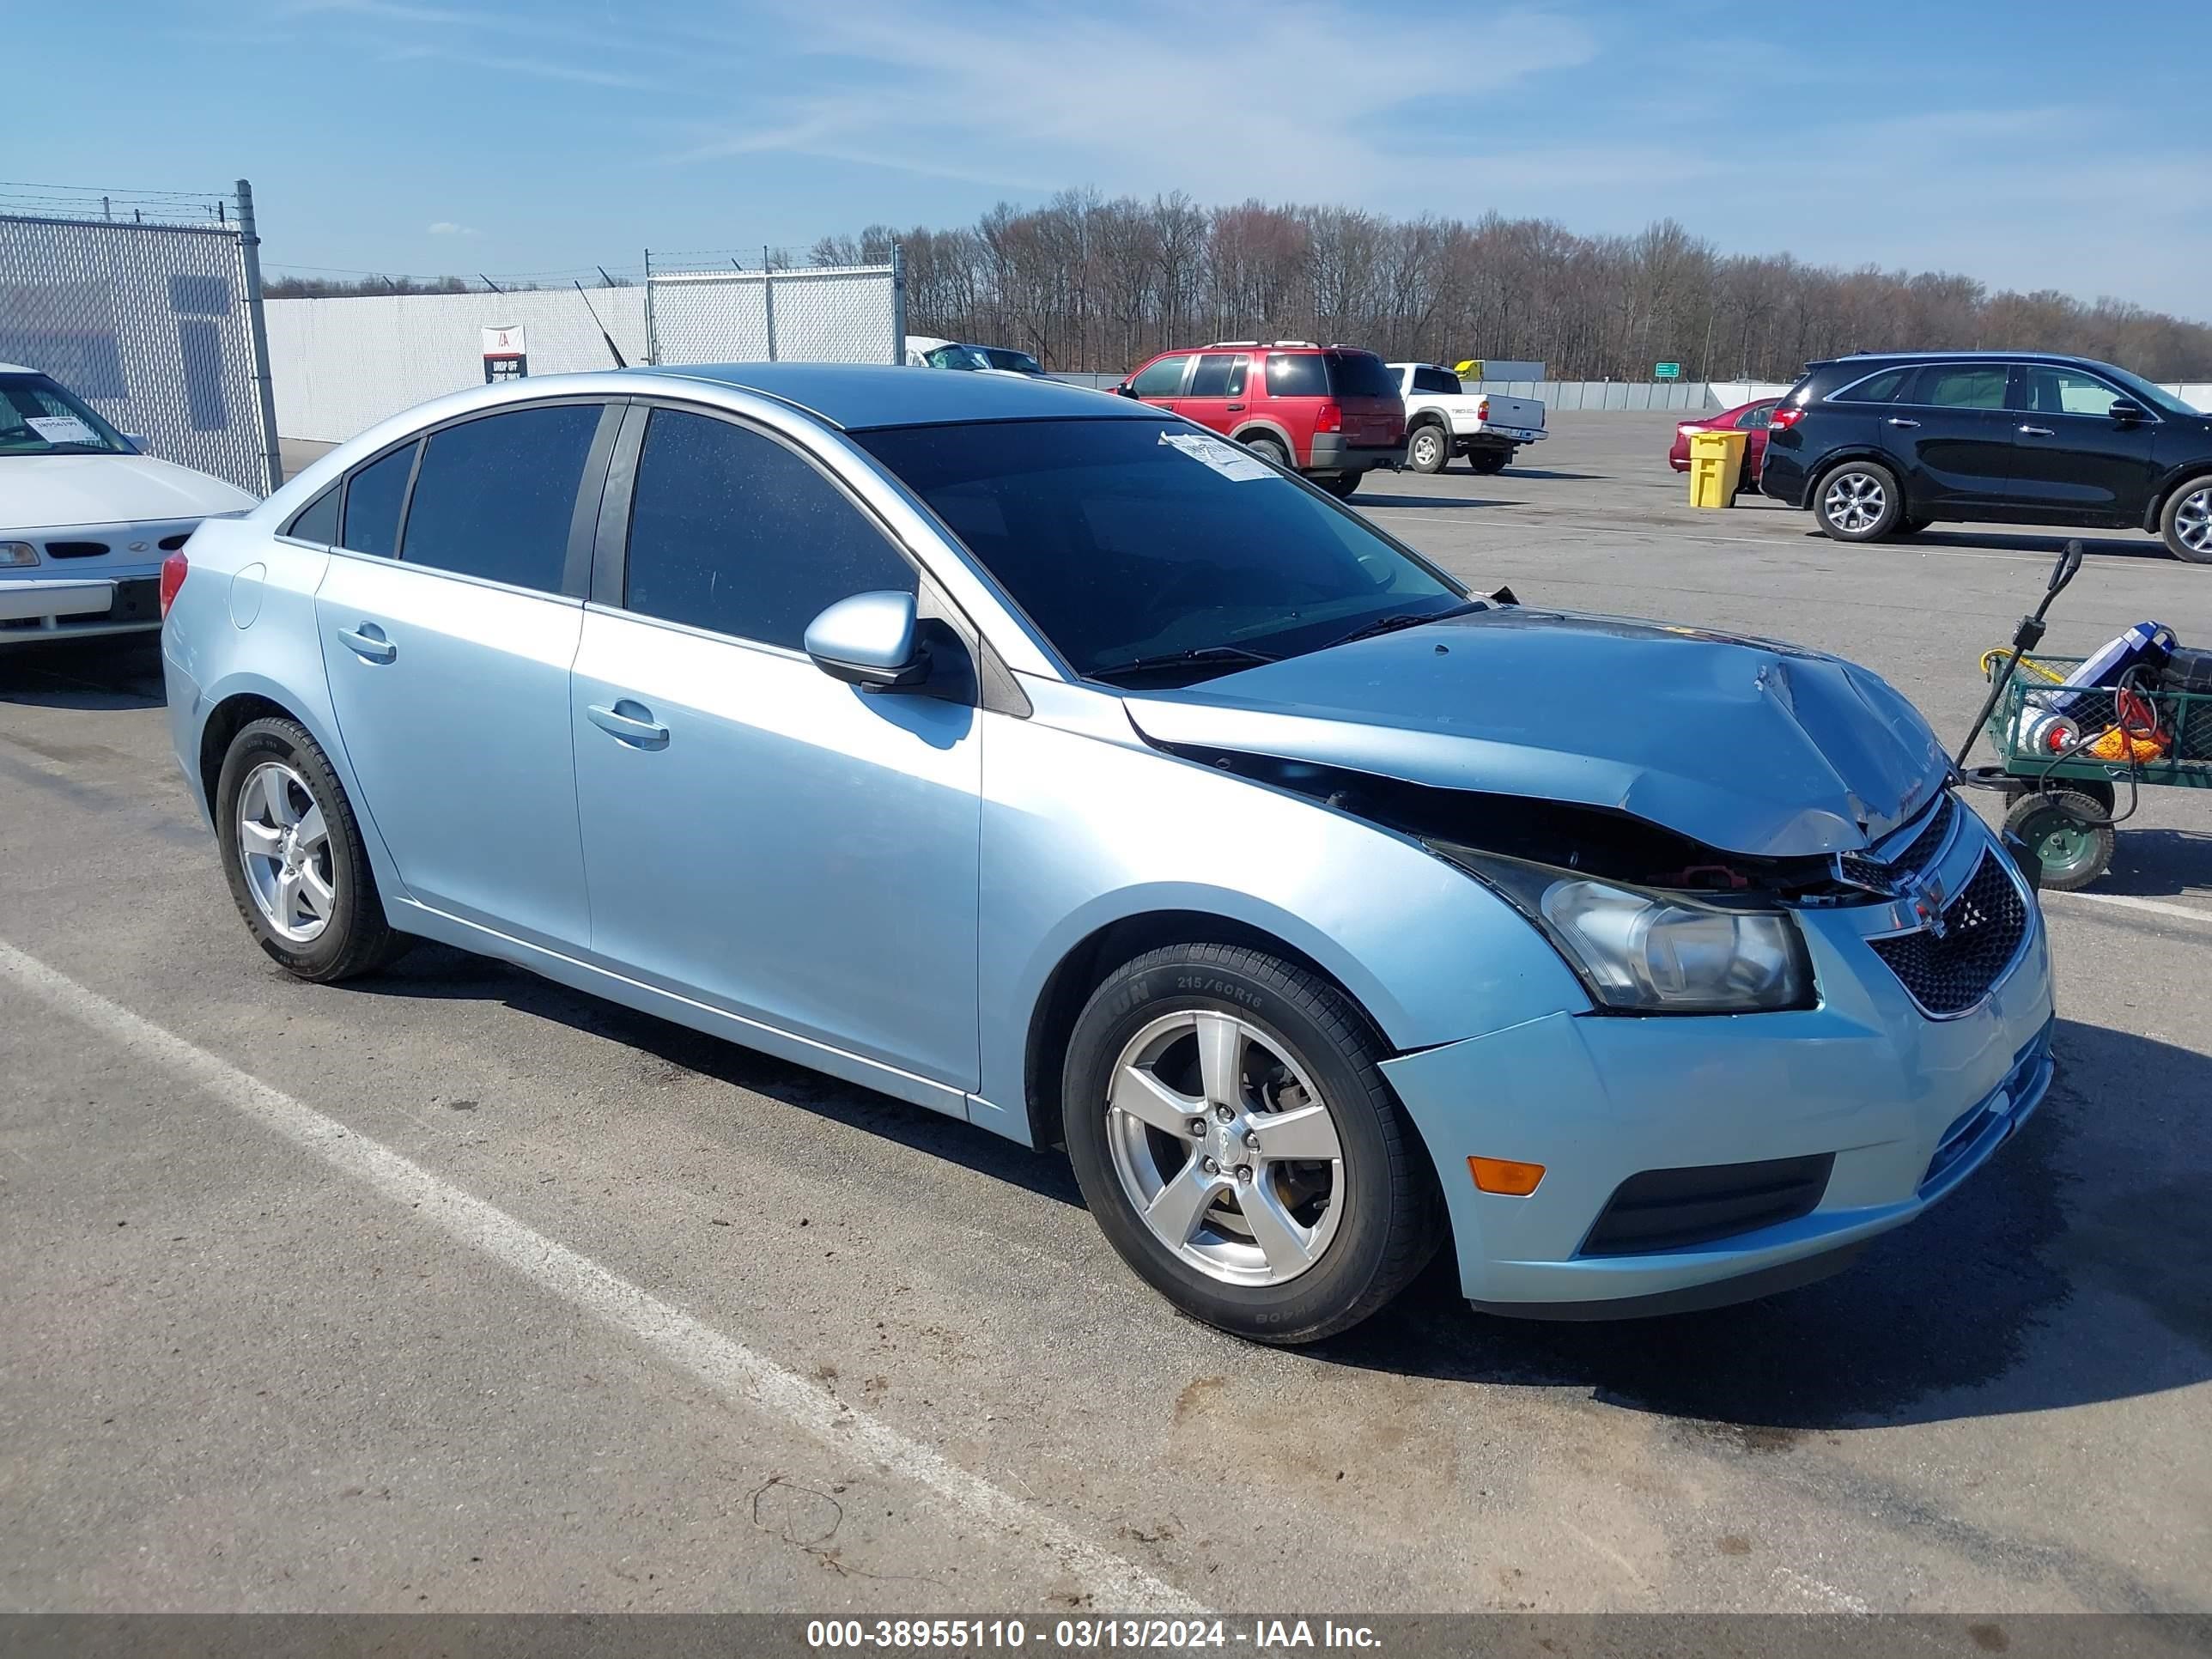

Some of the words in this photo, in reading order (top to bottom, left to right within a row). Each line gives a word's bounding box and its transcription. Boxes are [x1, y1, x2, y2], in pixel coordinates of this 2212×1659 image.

[493, 361, 507, 372] DROP
[507, 360, 519, 371] OFF
[1176, 975, 1263, 1009] 215/60R16
